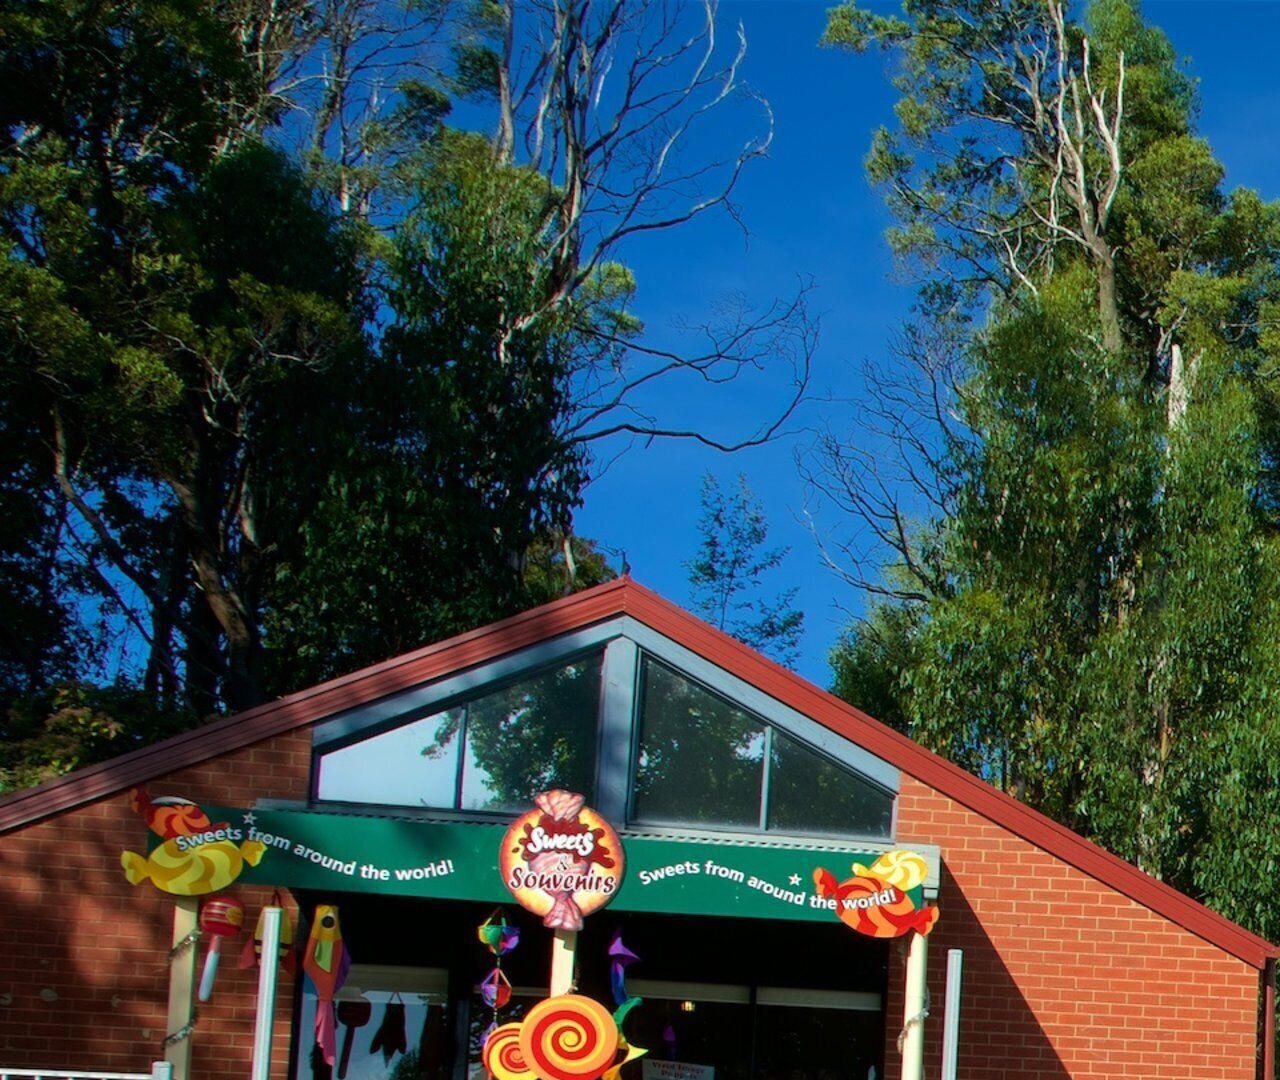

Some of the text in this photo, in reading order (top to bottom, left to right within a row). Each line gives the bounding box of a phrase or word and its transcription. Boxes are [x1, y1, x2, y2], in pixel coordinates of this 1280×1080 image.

[175, 825, 455, 881] Sweets from around the world!
[527, 827, 594, 856] Sweets
[510, 866, 616, 895] Souvenirs
[638, 860, 897, 910] Sweets from around the world!
